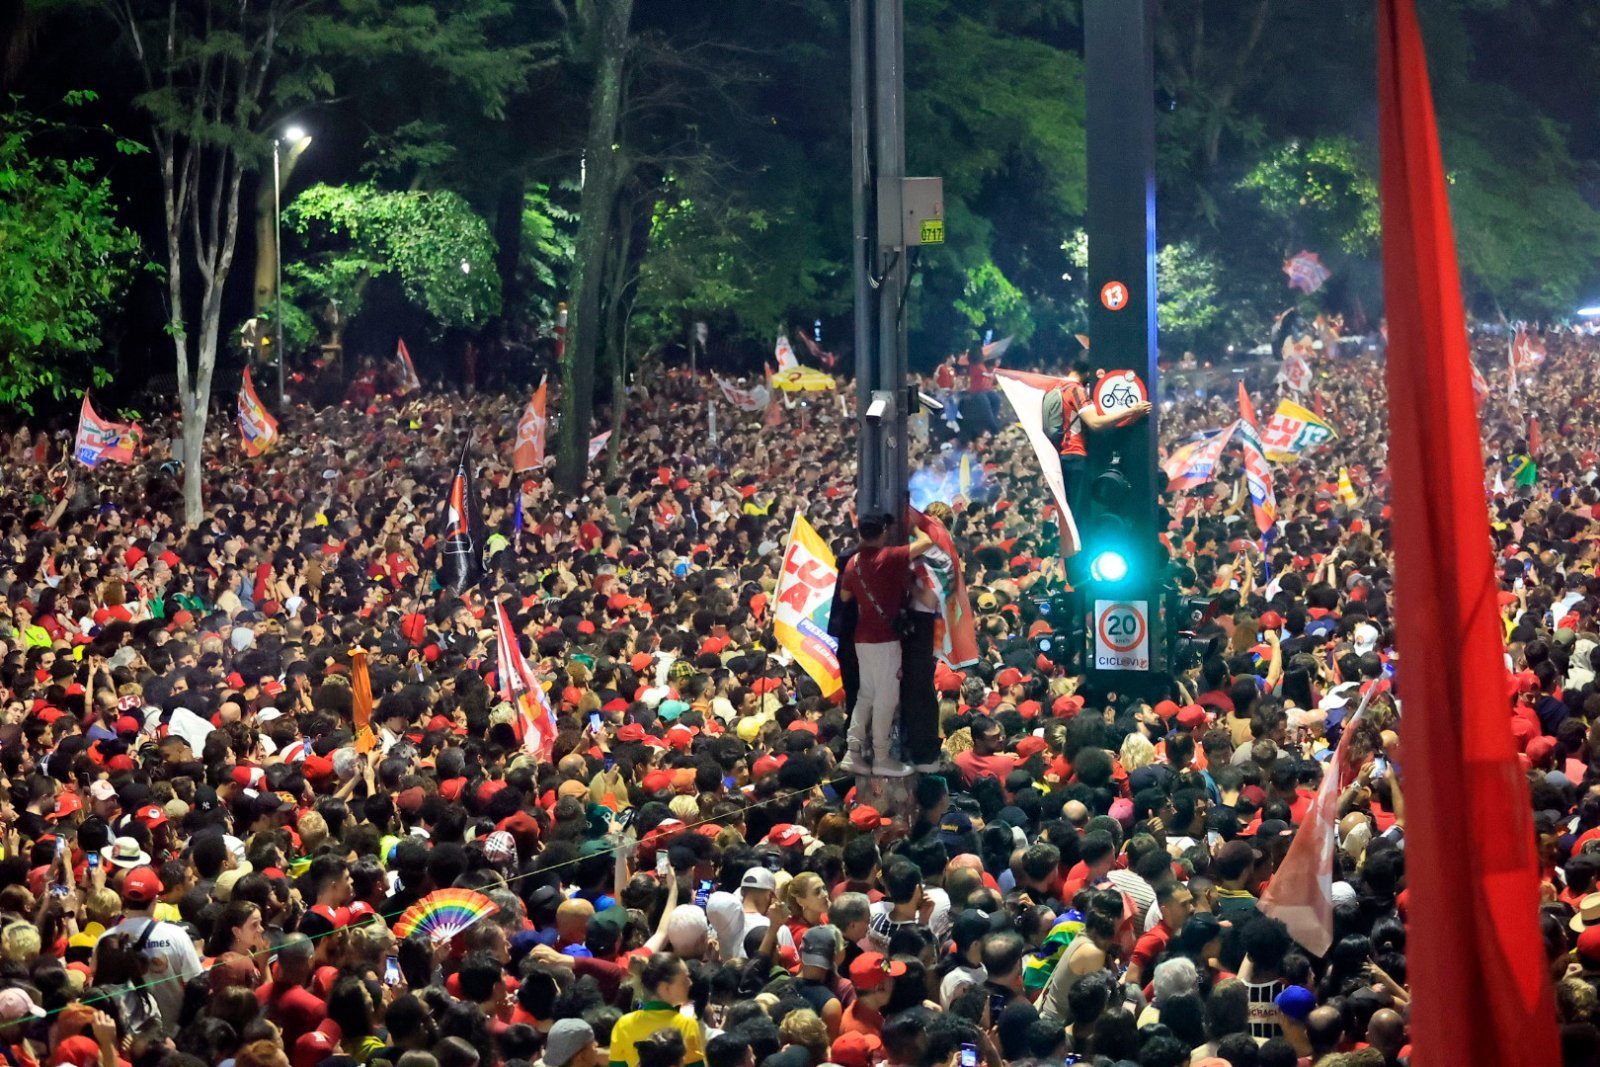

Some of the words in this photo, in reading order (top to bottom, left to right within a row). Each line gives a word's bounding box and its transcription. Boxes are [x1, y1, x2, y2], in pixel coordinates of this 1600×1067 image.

[1104, 285, 1123, 306] 13
[1108, 615, 1136, 635] 20
[1099, 656, 1146, 667] CICLVI
[121, 696, 140, 709] 13
[145, 939, 170, 949] imes
